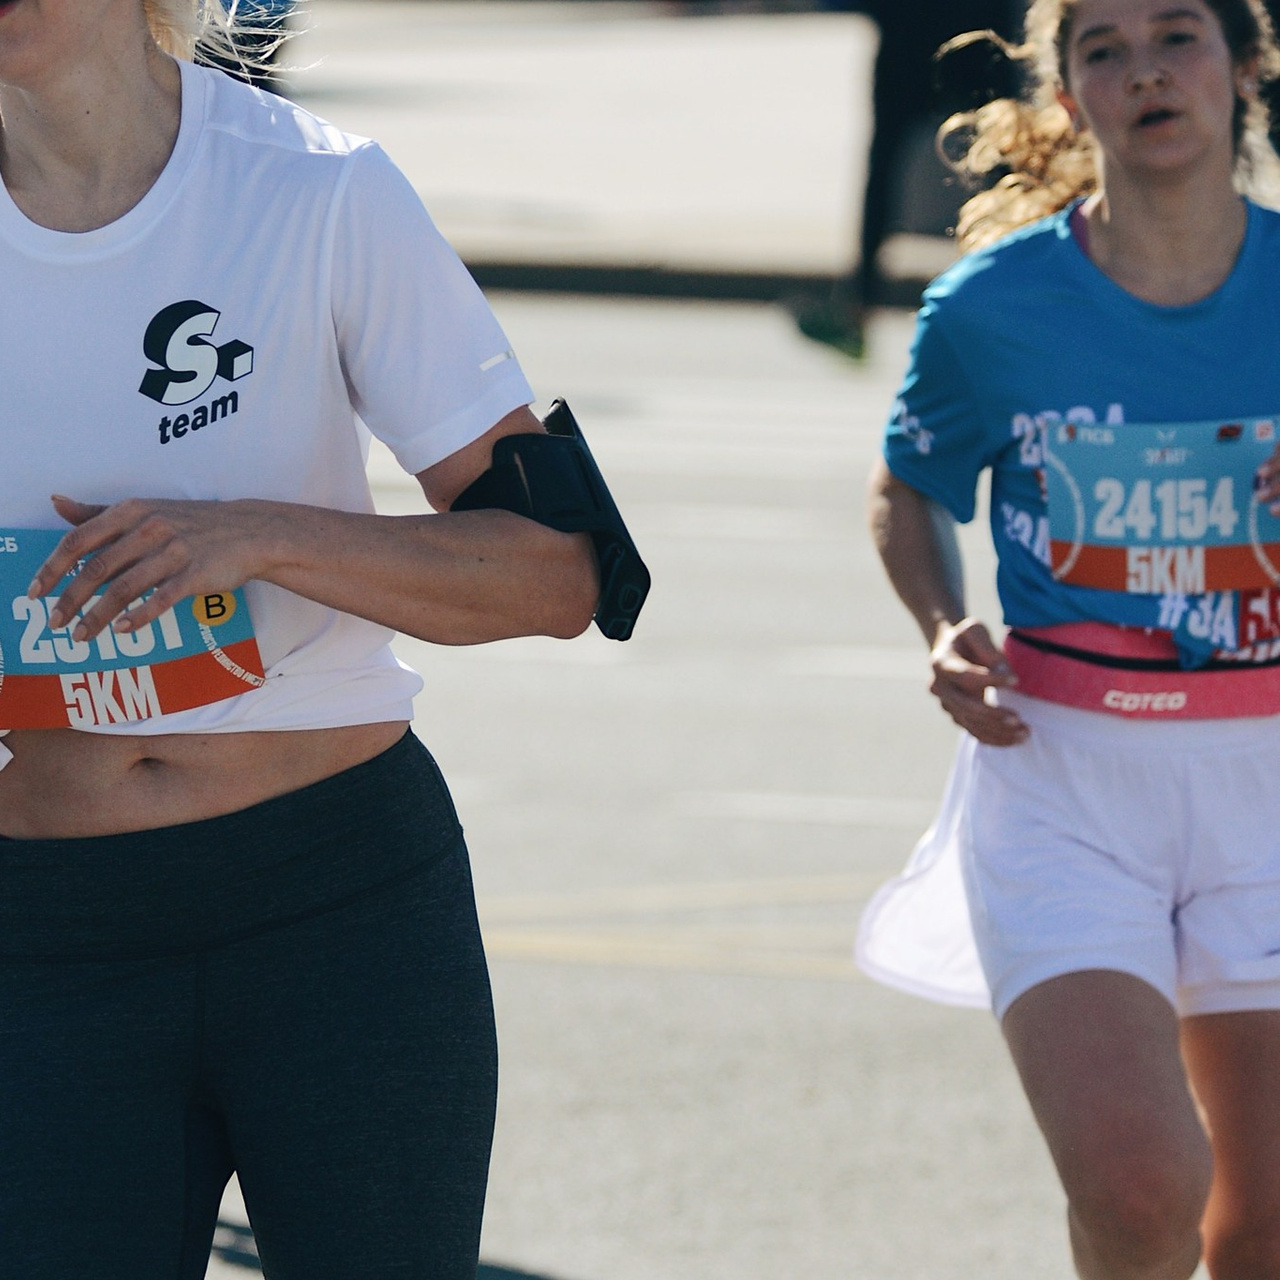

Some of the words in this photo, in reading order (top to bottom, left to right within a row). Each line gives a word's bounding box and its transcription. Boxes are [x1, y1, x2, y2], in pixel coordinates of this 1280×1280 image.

[158, 390, 239, 445] team
[1093, 476, 1239, 541] 24154
[1126, 545, 1206, 595] 5KM
[59, 665, 163, 727] 5KM
